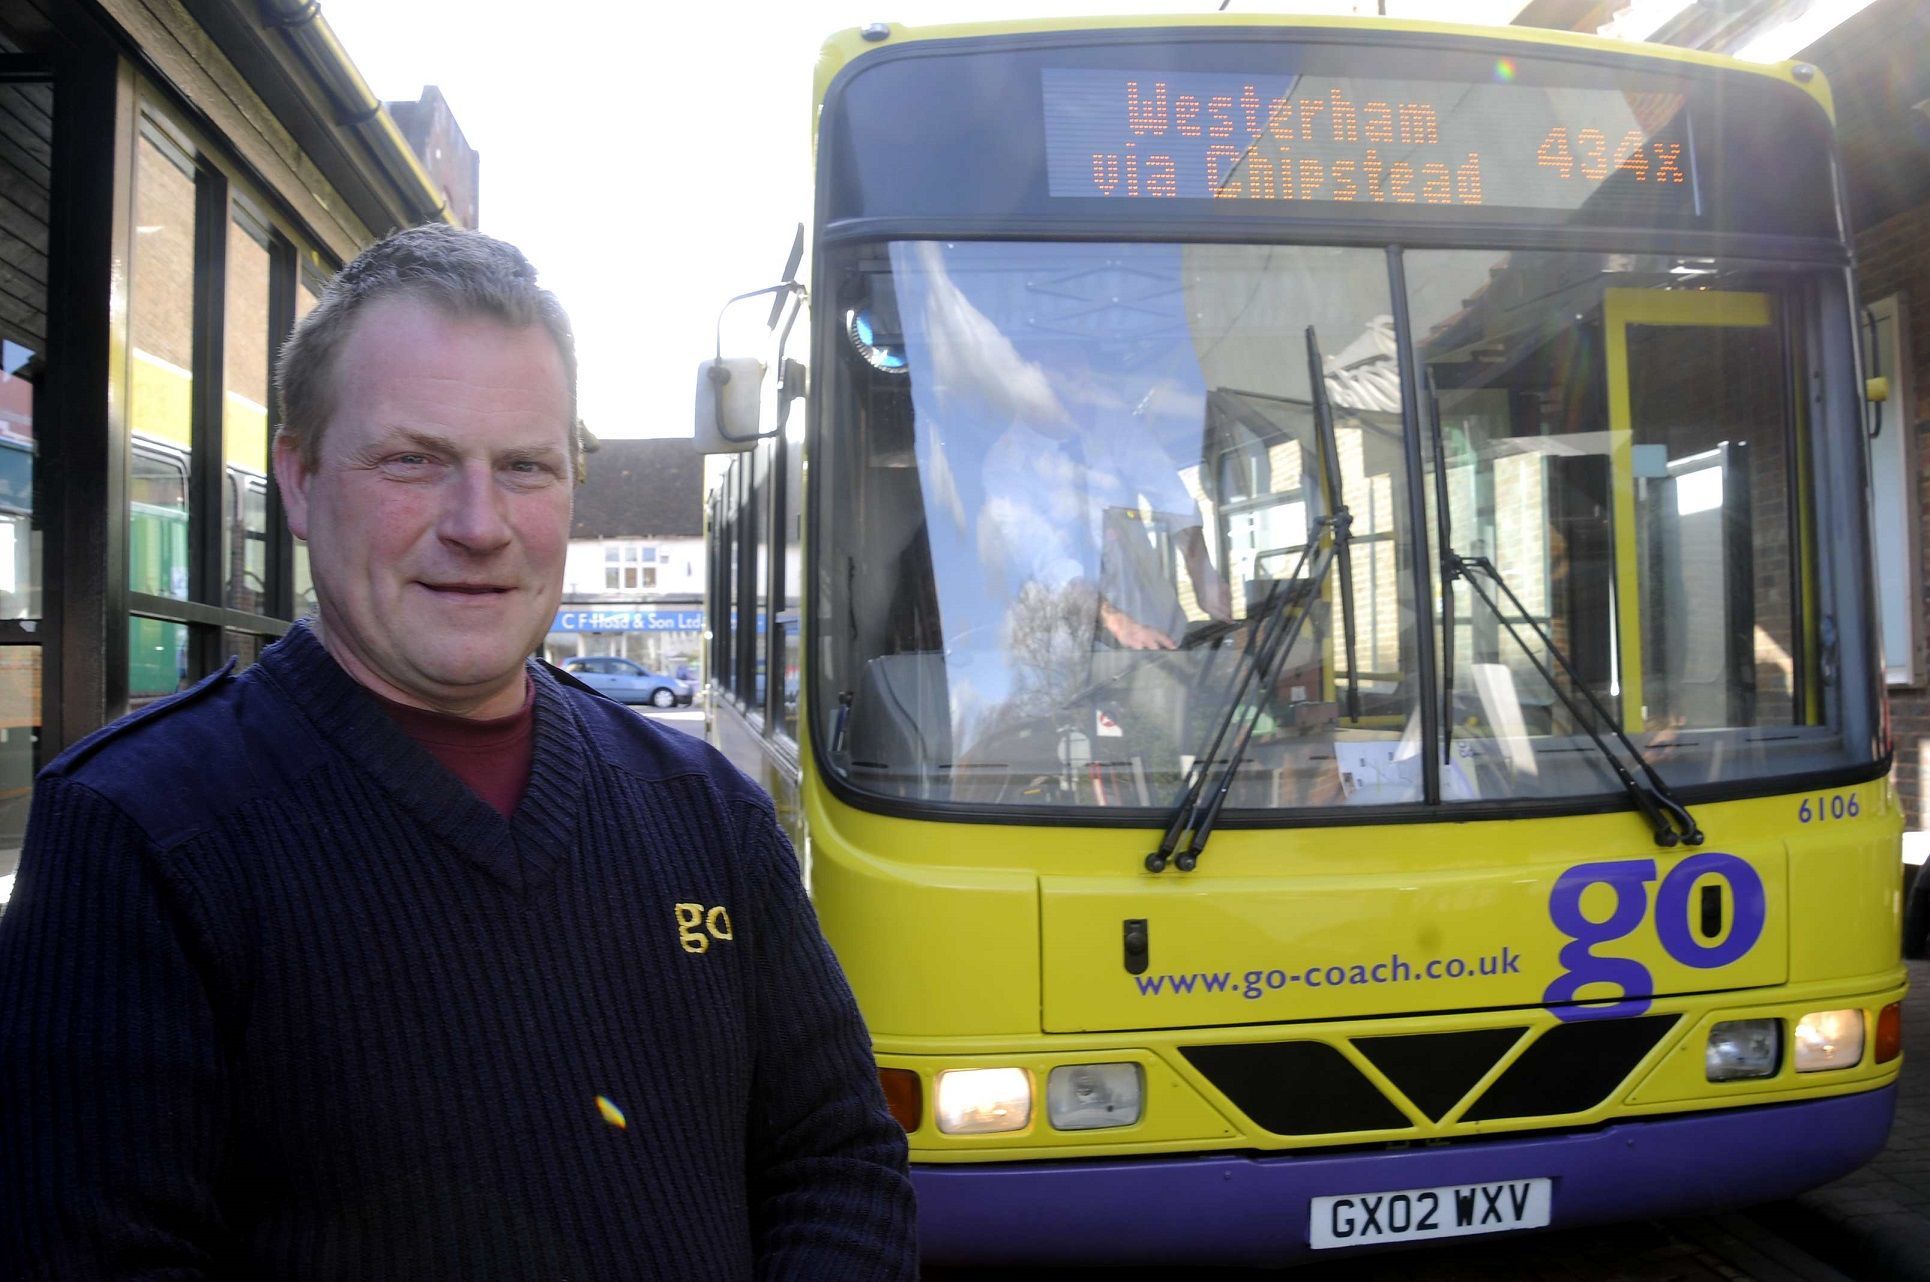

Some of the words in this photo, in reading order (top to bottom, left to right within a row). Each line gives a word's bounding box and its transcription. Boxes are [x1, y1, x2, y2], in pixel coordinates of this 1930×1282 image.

[1127, 81, 1438, 144] Westerham
[1092, 142, 1177, 198] via
[1206, 144, 1482, 205] Chipstead
[1536, 127, 1684, 184] 434x
[561, 613, 575, 629] C
[578, 613, 588, 629] F
[633, 613, 644, 629] &
[647, 613, 674, 629] Son
[1798, 793, 1860, 823] 6106
[674, 902, 734, 954] go
[1542, 852, 1766, 1022] go
[1135, 947, 1521, 1000] www.go-coach.co.uk
[1332, 1191, 1439, 1239] GX02
[1454, 1182, 1531, 1228] WXV
